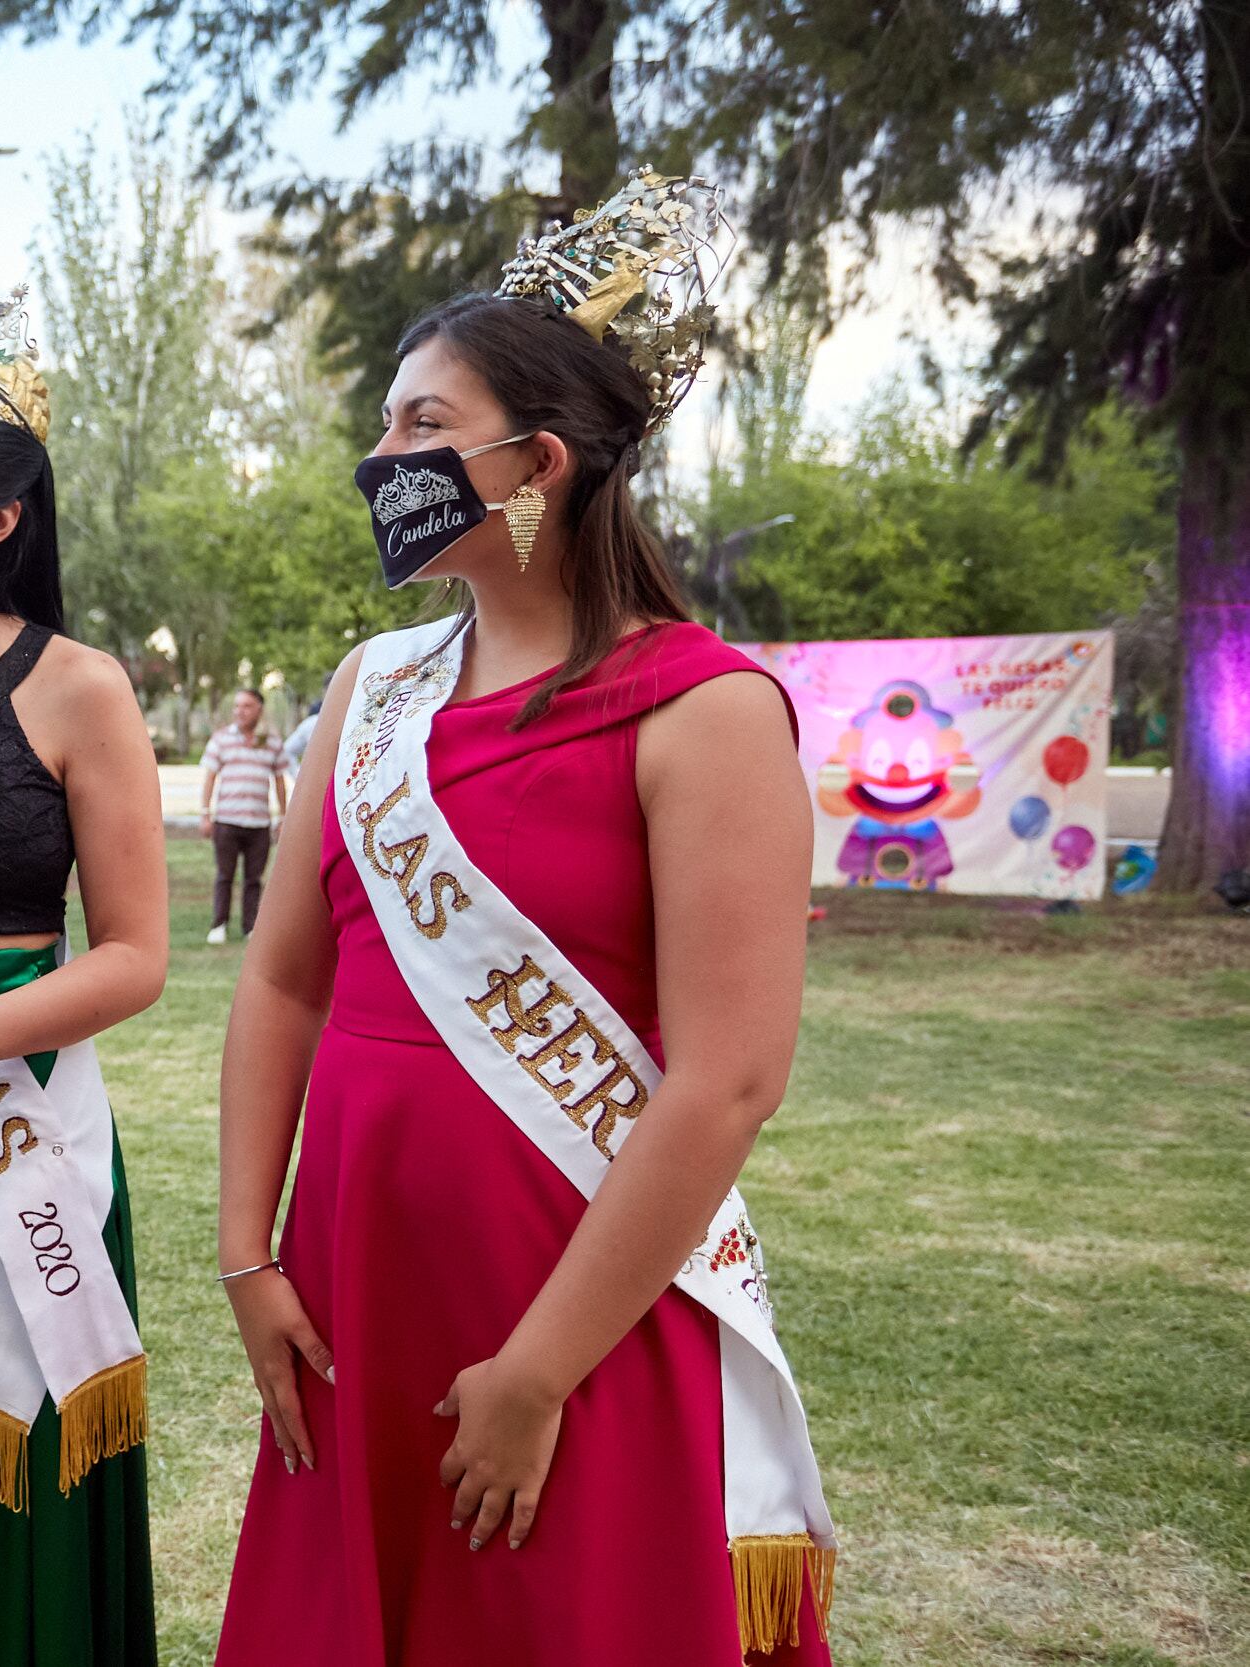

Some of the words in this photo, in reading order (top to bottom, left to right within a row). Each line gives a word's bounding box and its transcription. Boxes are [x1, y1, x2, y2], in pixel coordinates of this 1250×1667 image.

[387, 504, 466, 558] Candela
[374, 692, 411, 763] REINA
[355, 772, 471, 940] LAS
[465, 953, 650, 1163] HER
[18, 1202, 81, 1297] 2020
